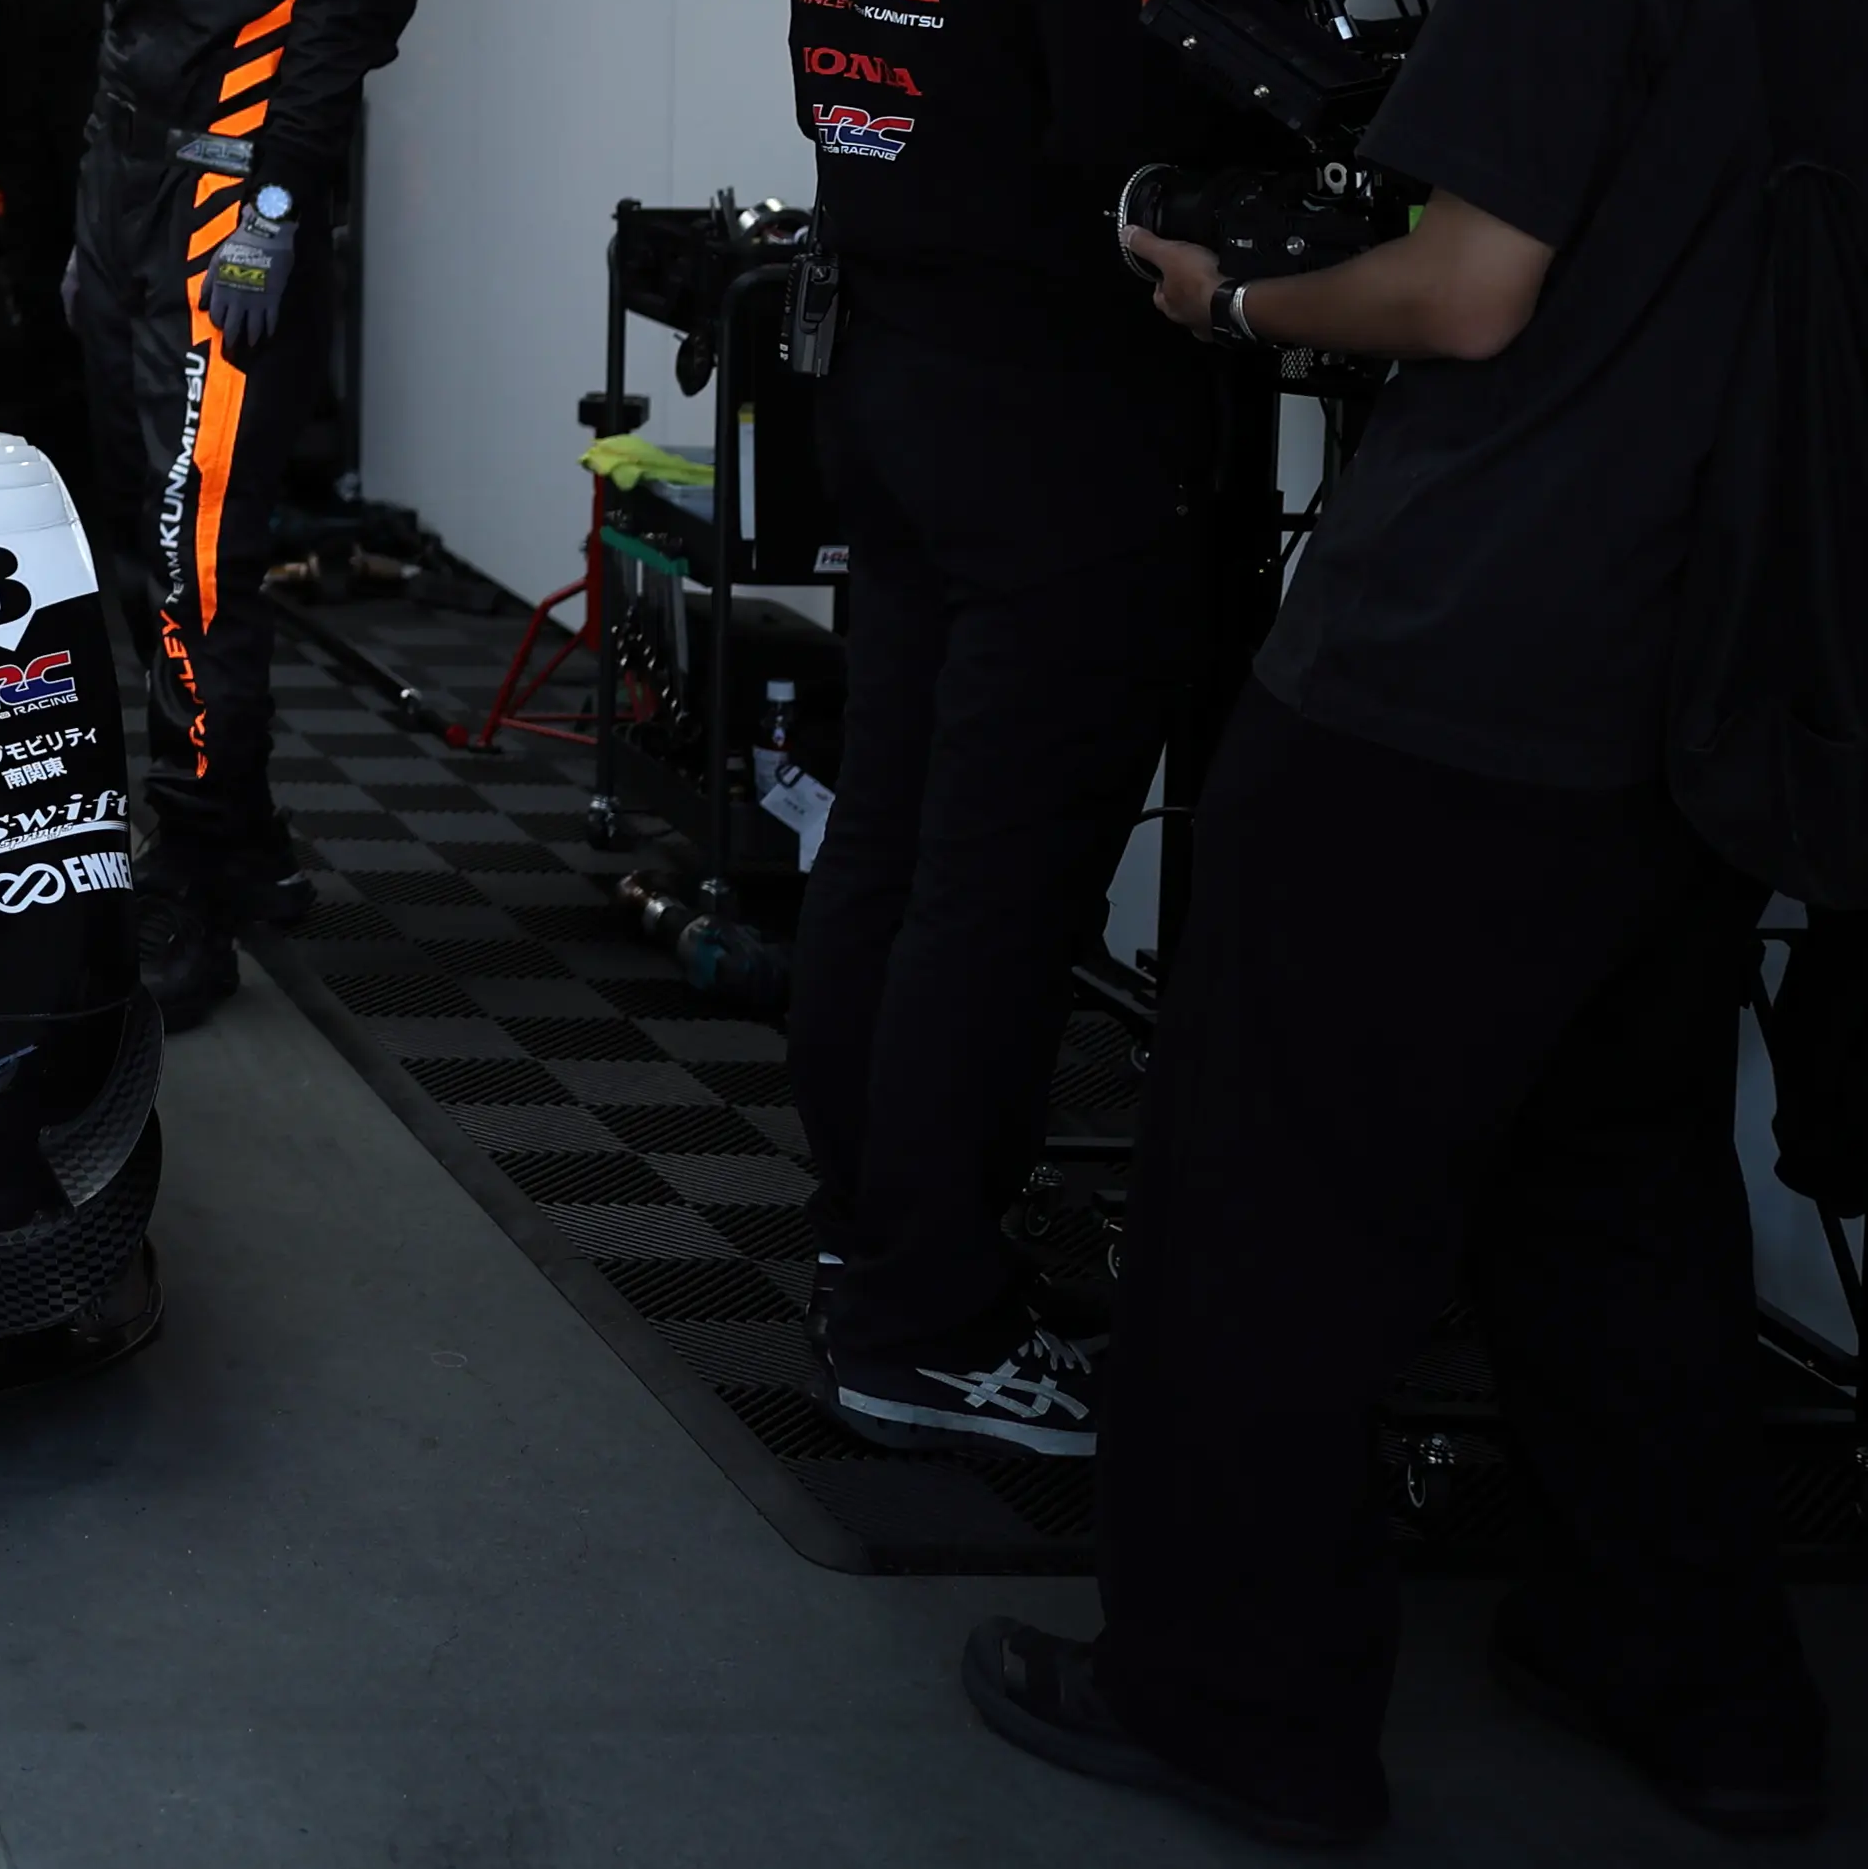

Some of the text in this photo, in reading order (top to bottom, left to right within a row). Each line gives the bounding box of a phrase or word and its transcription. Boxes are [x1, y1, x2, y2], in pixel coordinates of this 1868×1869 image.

[812, 103, 916, 155] HRC
[840, 145, 897, 162] RACING
[159, 352, 206, 549] KUNIMITSU
[13, 692, 79, 716] RACING
[0, 755, 68, 790] 南関東
